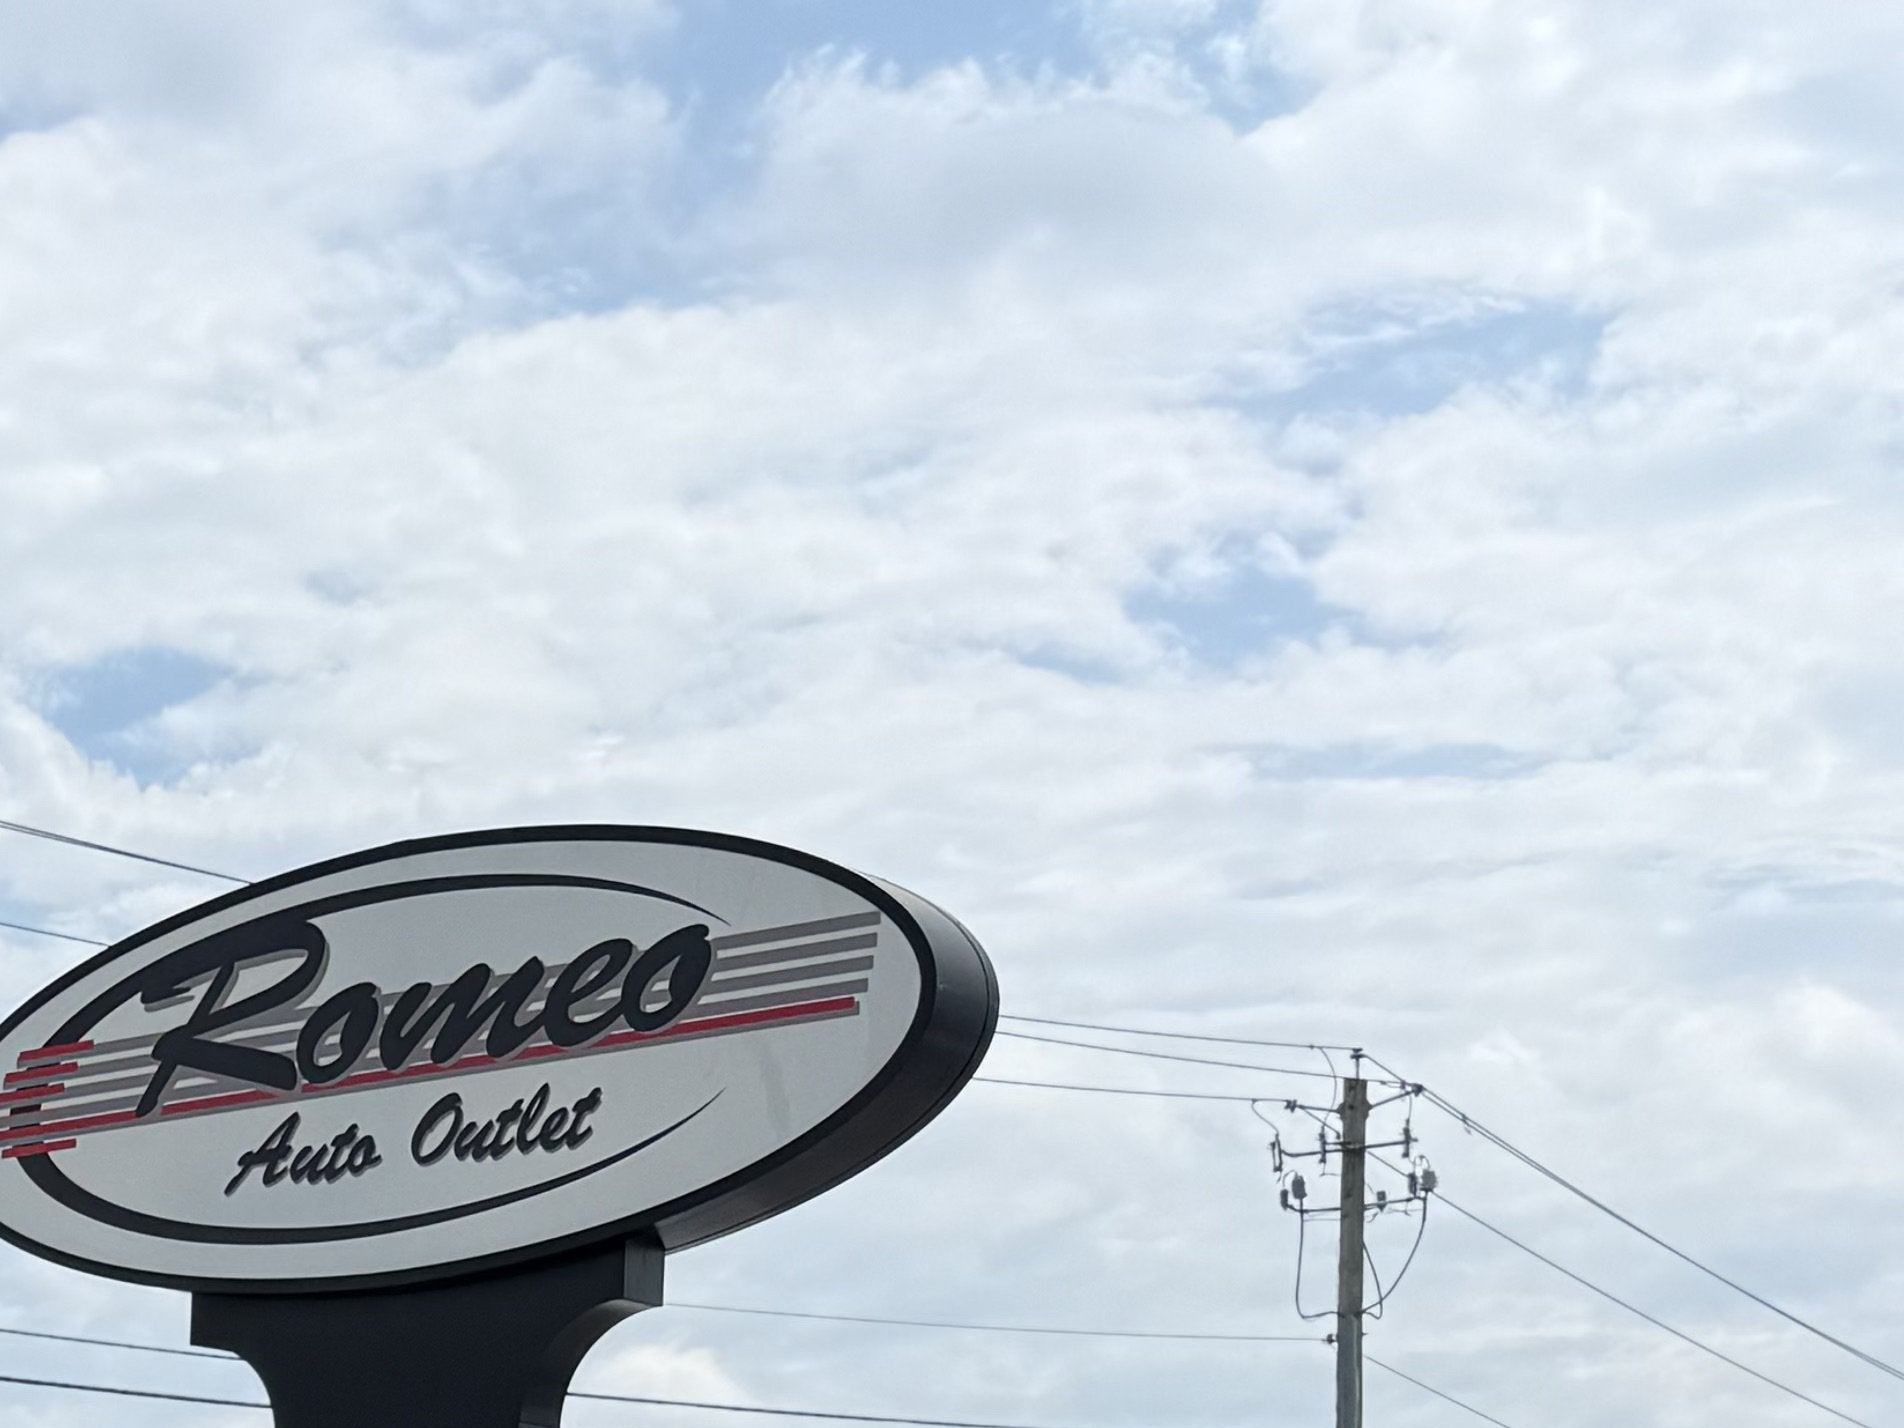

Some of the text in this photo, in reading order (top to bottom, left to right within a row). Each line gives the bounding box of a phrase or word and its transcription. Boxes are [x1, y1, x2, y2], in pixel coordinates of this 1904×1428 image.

[136, 917, 712, 1118] Romeo
[225, 1085, 603, 1196] Auto Outlet
